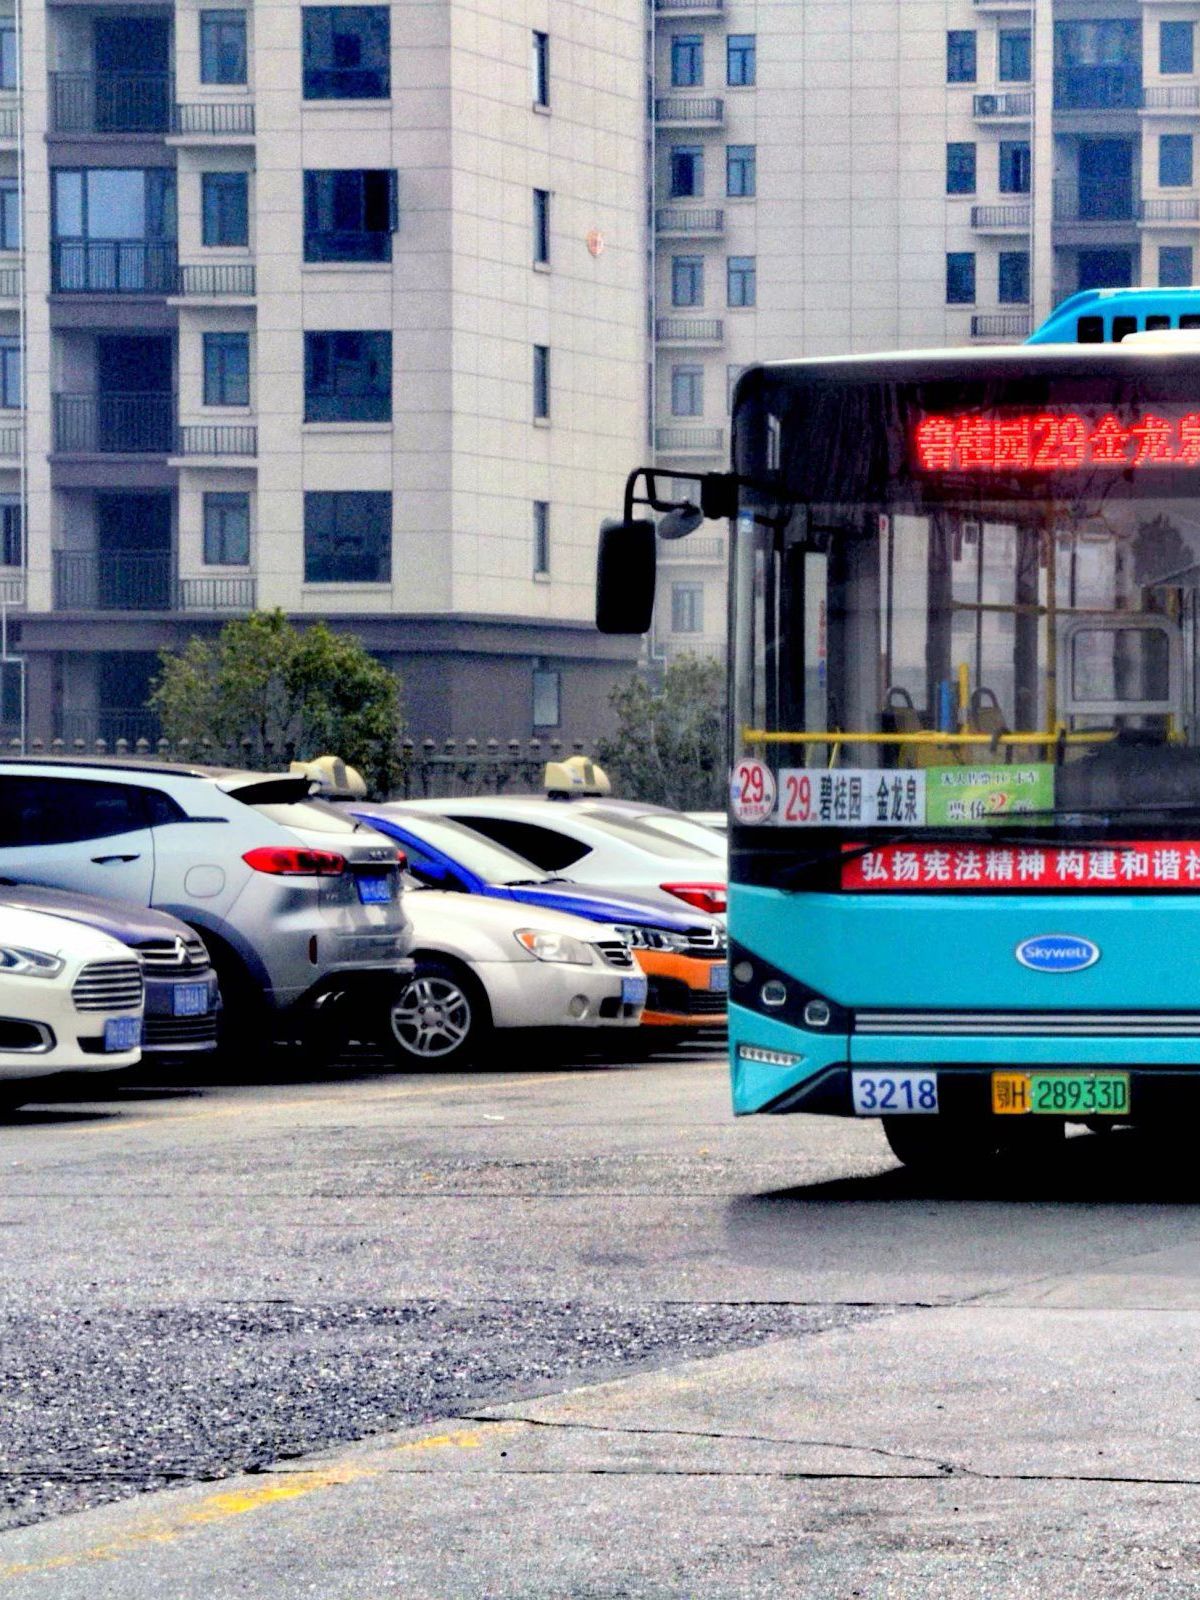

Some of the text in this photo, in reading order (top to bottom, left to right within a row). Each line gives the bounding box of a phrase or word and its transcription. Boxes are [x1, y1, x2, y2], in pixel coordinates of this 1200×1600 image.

[861, 850, 1046, 881] 弘扬宪法精神
[1025, 946, 1089, 960] Skywell
[859, 1079, 937, 1110] 3218
